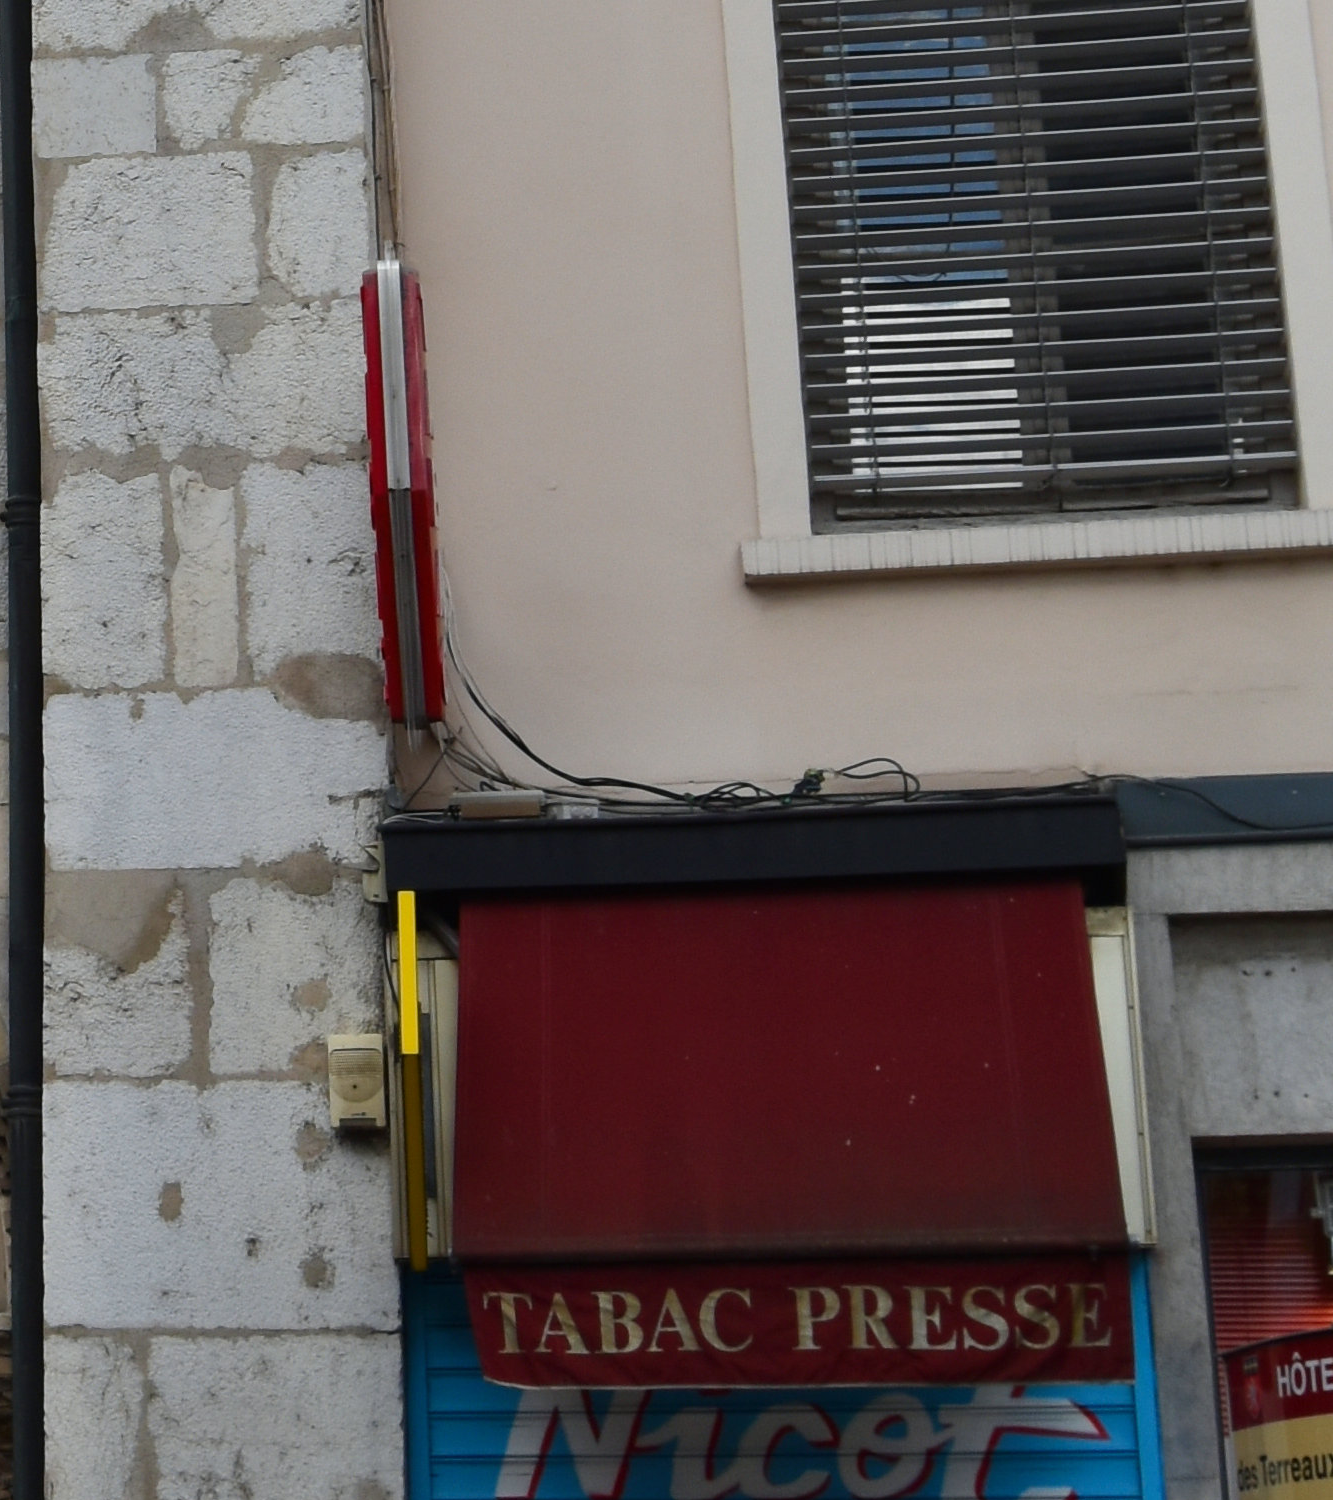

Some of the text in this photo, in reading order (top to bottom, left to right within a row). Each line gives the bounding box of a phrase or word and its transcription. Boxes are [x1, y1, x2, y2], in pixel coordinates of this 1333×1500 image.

[483, 1282, 1111, 1355] TABAC PRESSE
[1237, 1460, 1258, 1492] des
